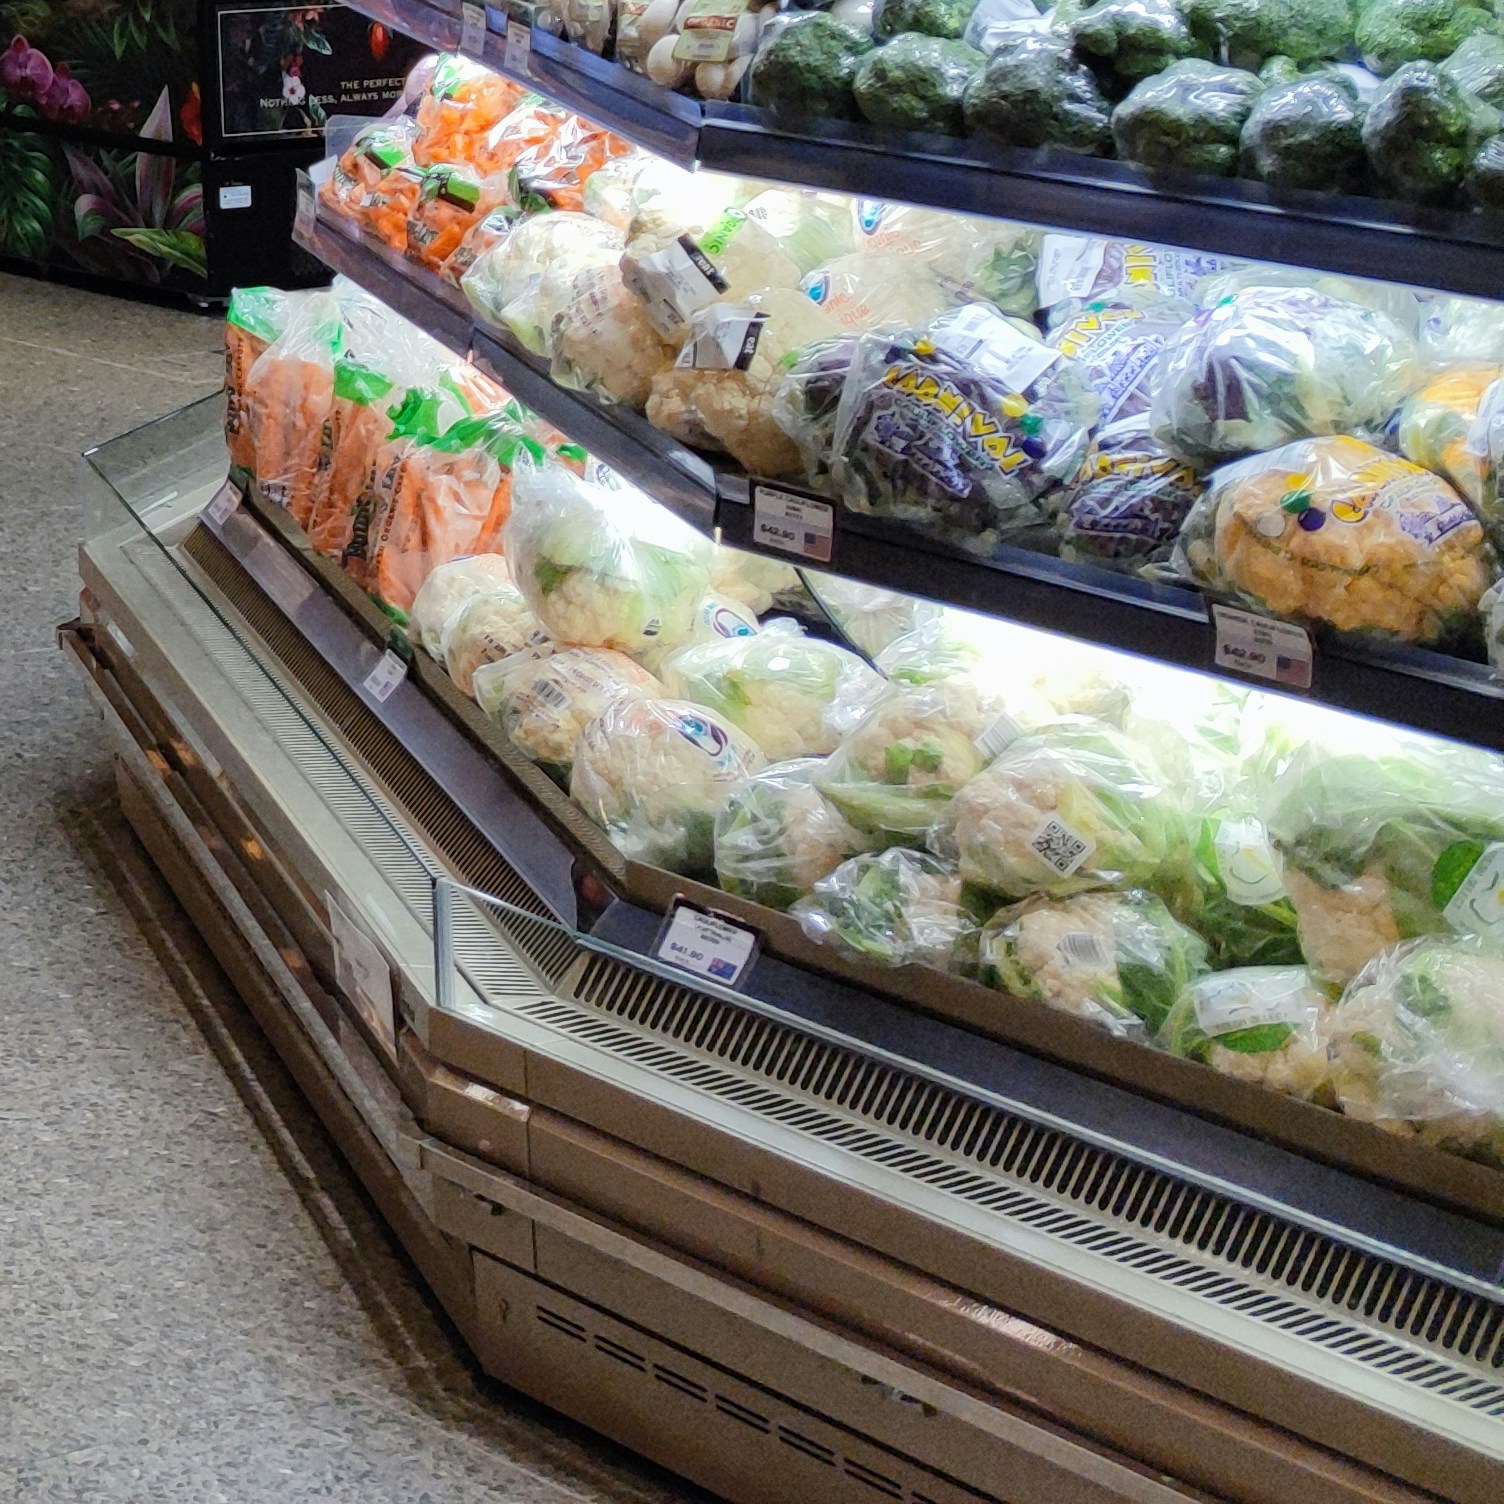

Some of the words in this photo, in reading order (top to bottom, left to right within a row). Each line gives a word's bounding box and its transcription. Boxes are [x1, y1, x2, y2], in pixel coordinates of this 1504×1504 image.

[340, 80, 359, 89] THE
[363, 77, 406, 88] PERFECT
[340, 93, 379, 103] ALWAYS
